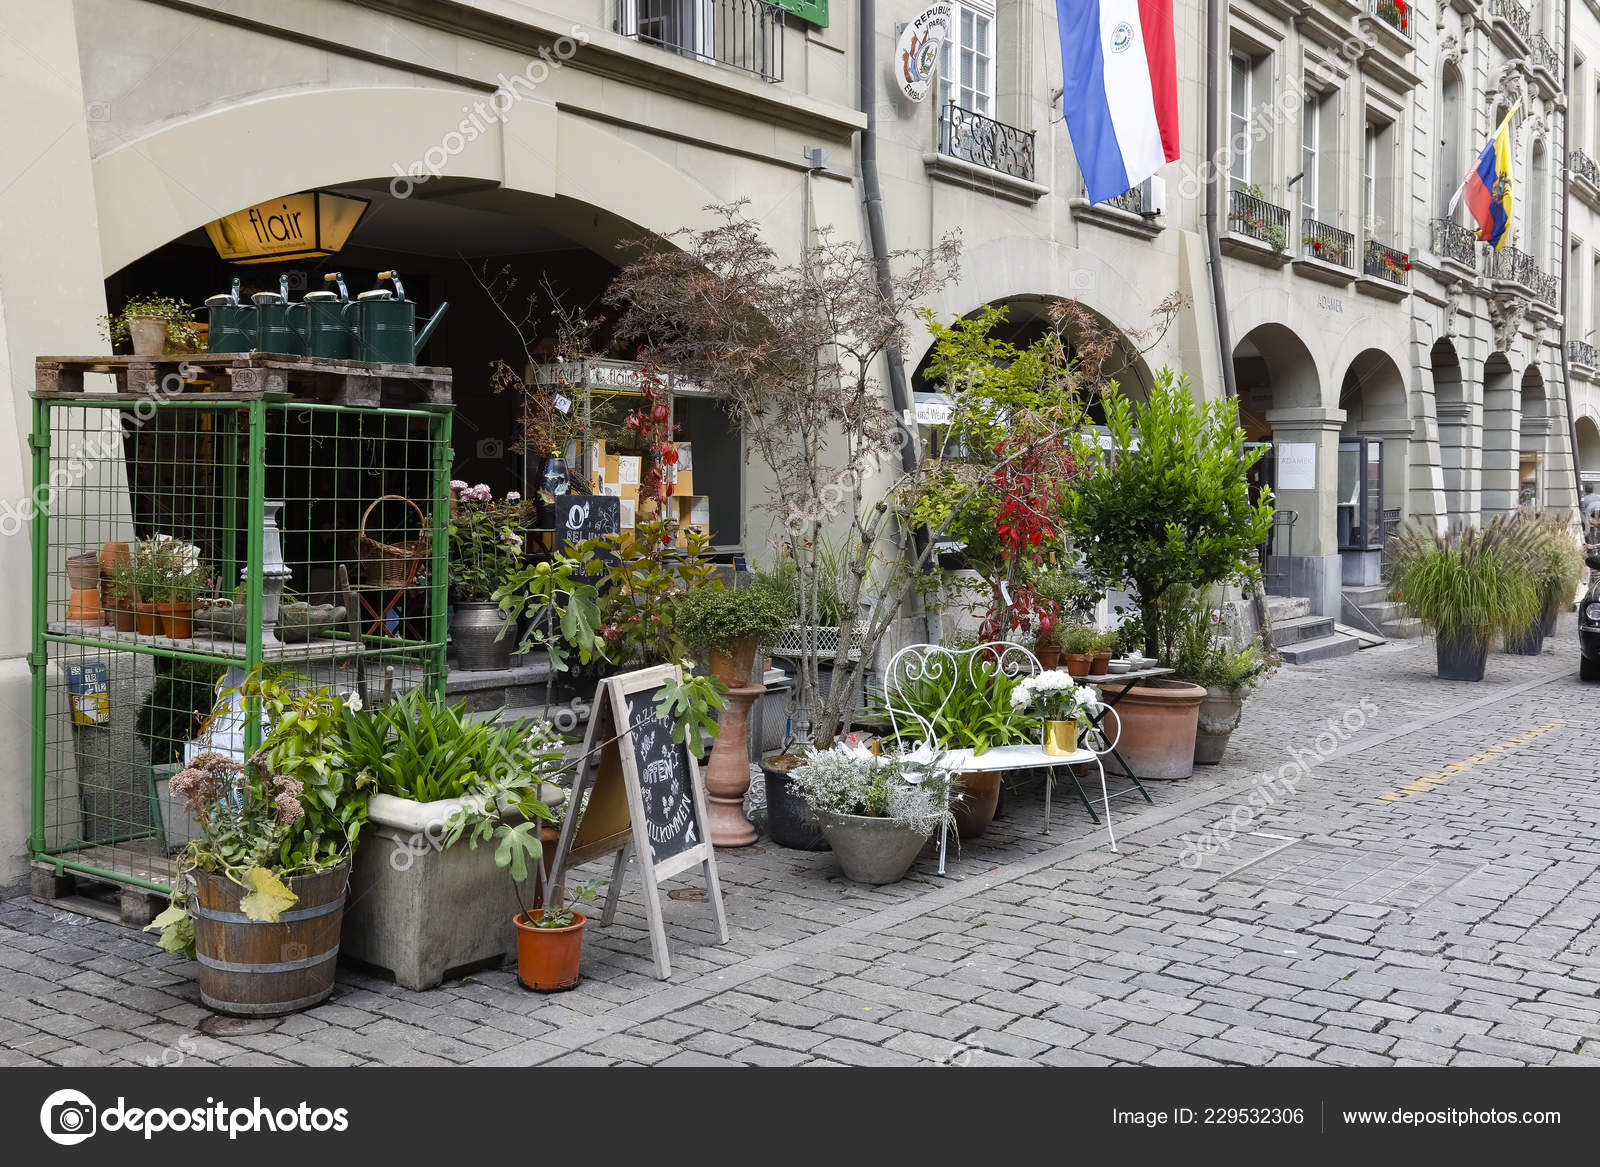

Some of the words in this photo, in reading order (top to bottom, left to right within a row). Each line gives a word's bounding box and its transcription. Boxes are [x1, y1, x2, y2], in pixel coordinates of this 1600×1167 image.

[249, 204, 303, 243] flair
[1280, 456, 1313, 465] ADAMEK
[642, 758, 674, 784] OFFEN
